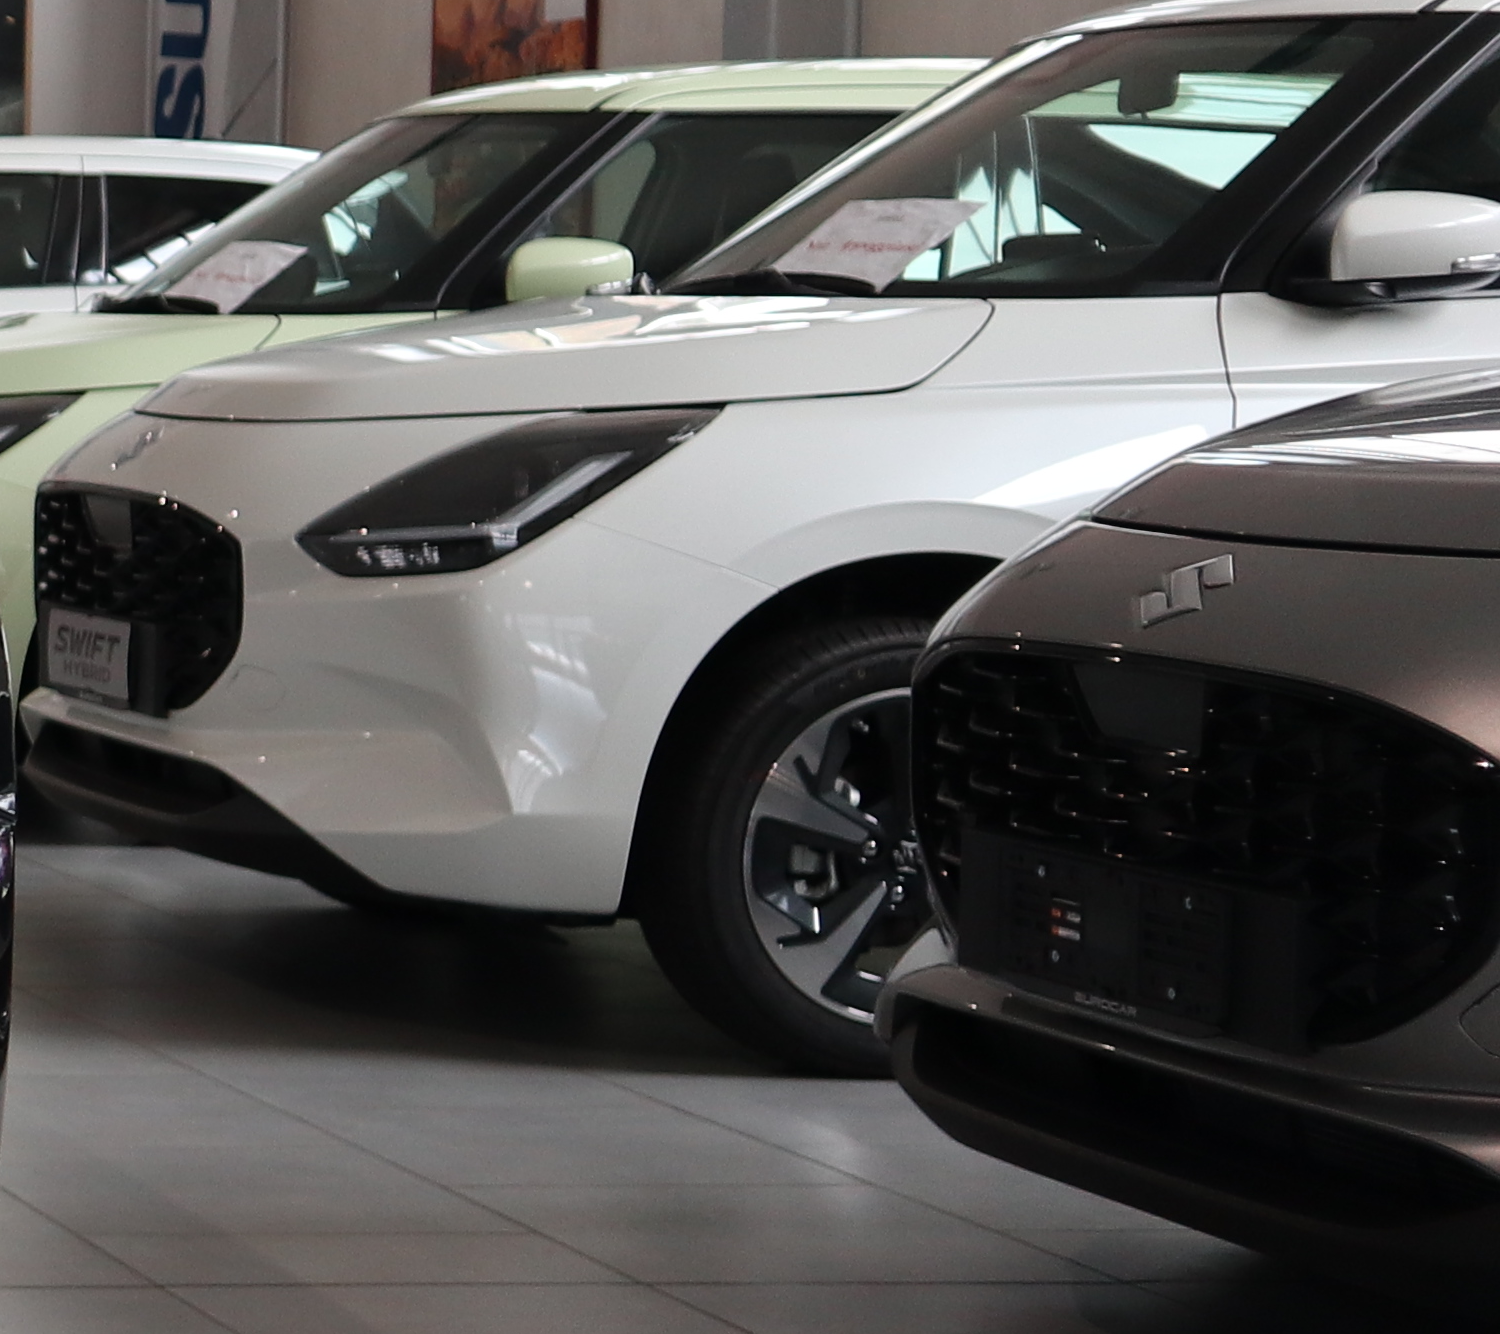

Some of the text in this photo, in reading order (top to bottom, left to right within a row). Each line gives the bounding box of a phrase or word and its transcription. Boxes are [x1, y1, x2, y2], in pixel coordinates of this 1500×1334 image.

[54, 623, 121, 663] SWIFT
[63, 658, 112, 683] HYBRID
[1074, 990, 1138, 1017] EUROCAR
